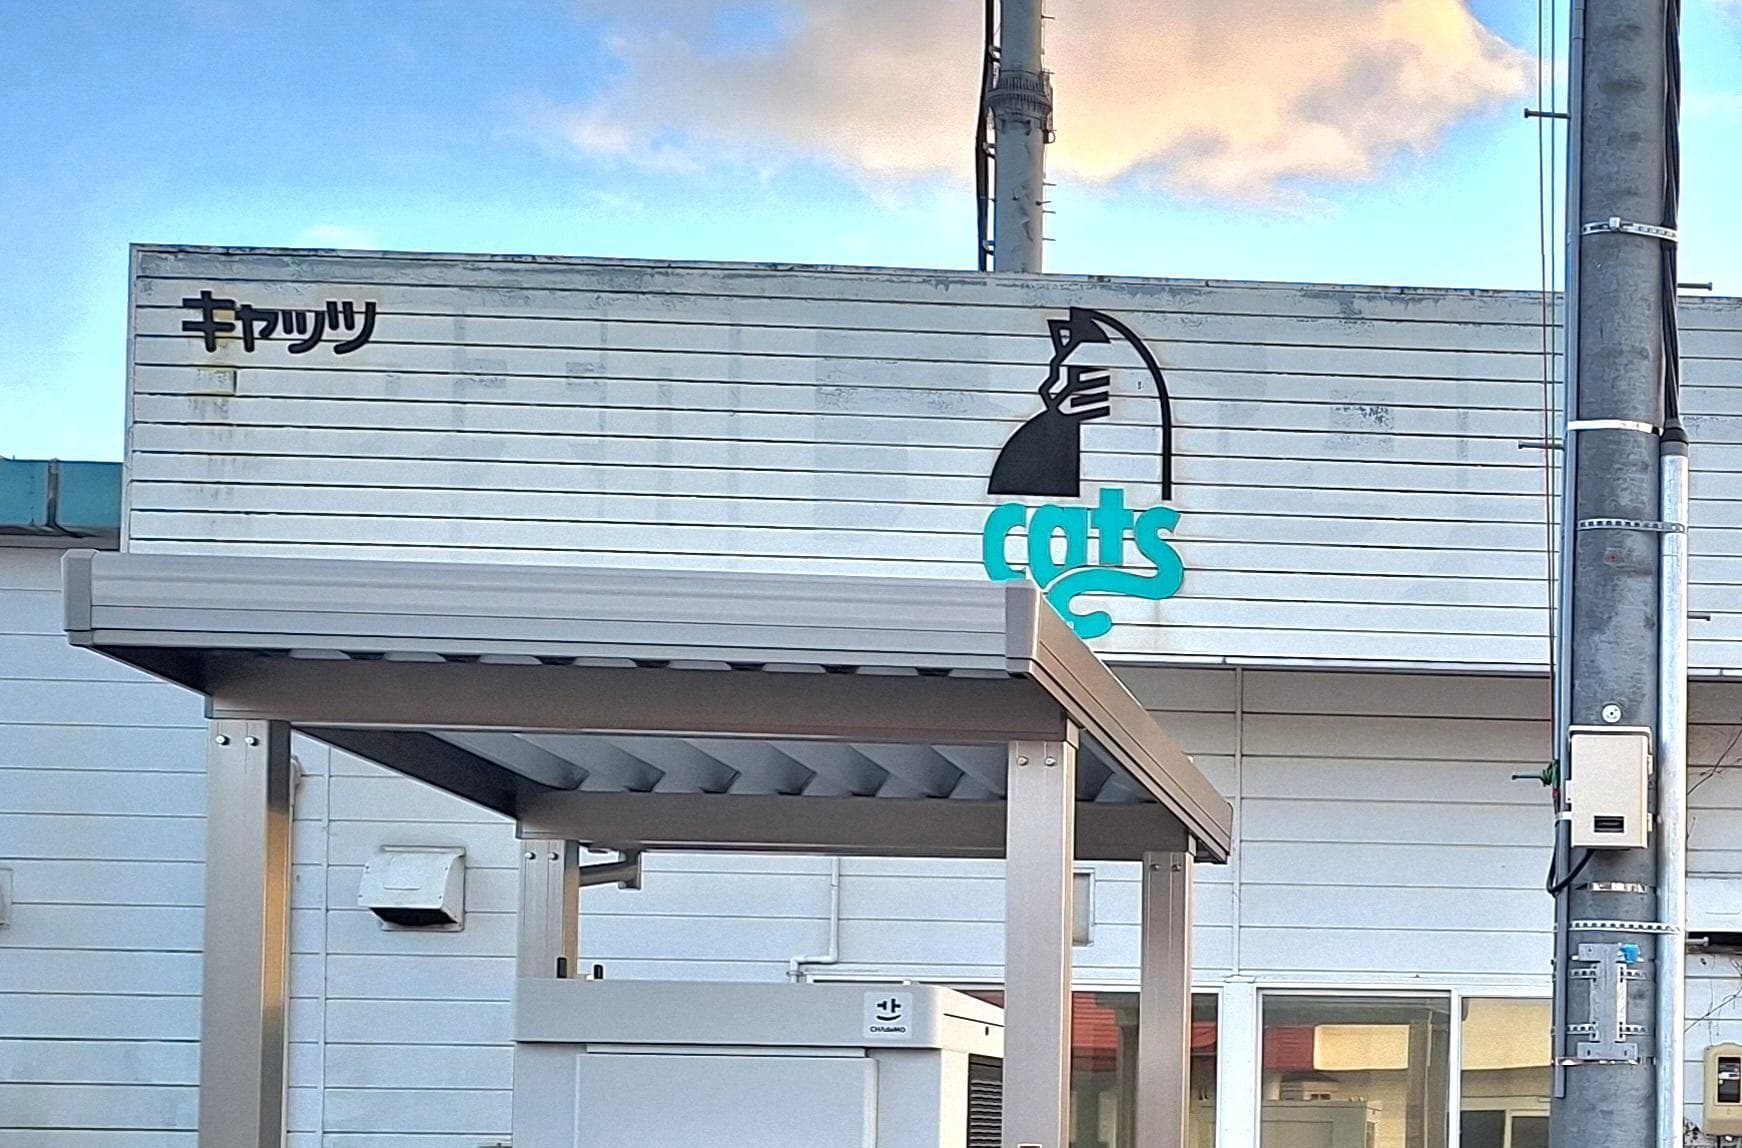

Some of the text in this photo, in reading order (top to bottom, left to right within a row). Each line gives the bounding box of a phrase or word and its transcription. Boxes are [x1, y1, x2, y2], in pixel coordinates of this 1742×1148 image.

[182, 290, 377, 355] キャッツ
[983, 488, 1185, 640] cats
